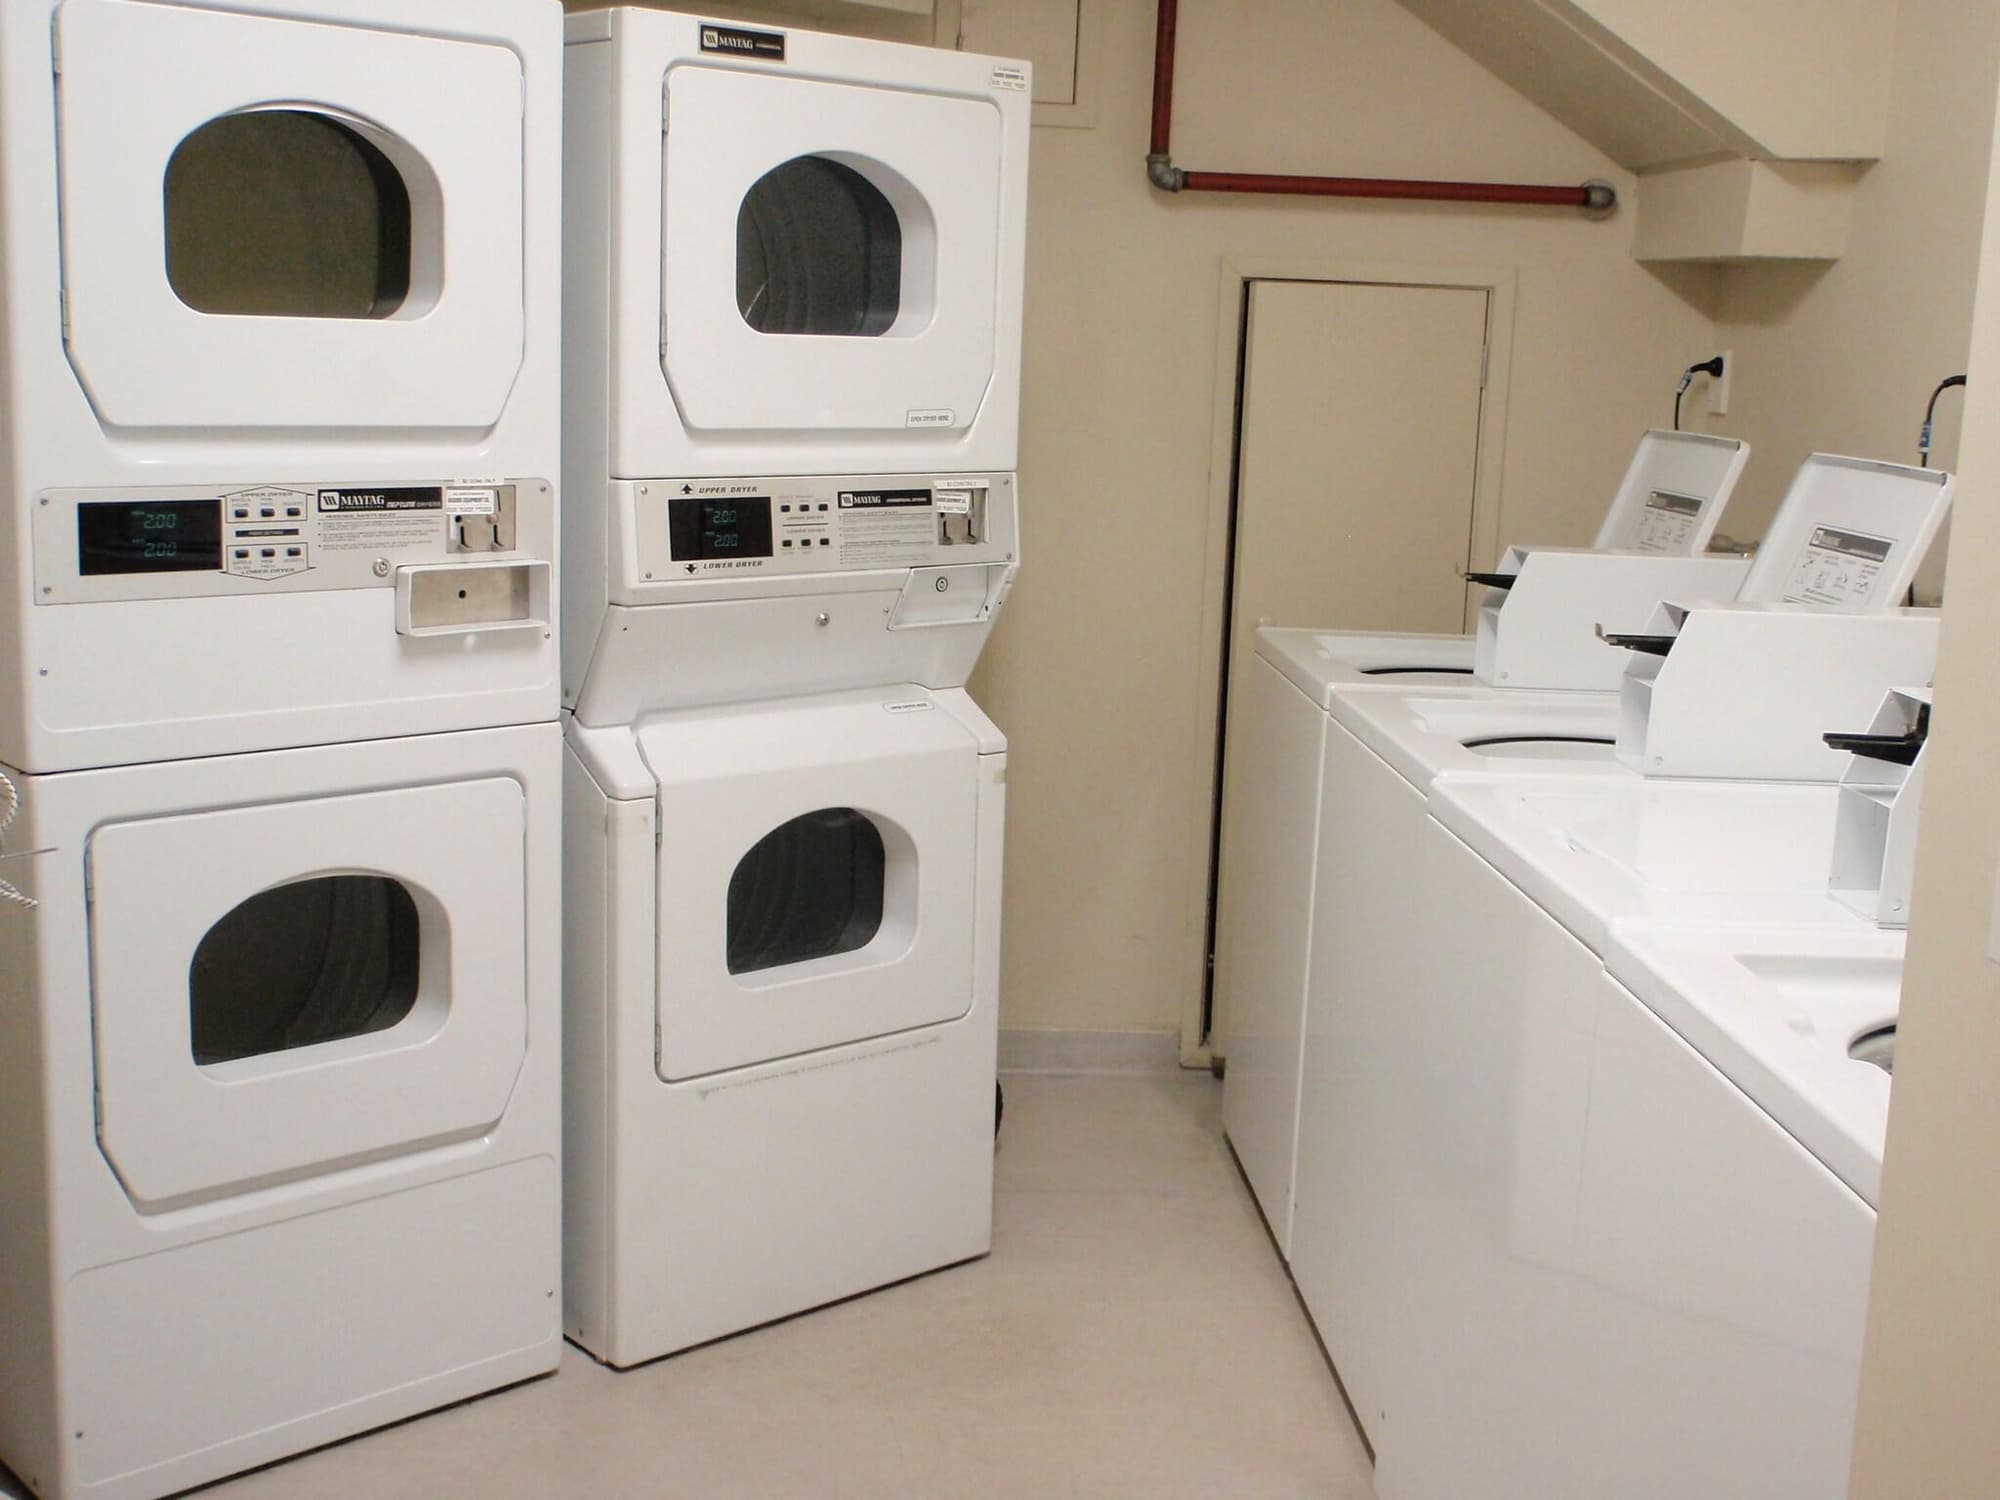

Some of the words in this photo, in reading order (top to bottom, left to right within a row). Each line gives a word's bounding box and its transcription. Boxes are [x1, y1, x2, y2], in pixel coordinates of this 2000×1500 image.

[719, 36, 753, 49] MAYTAG
[340, 495, 385, 505] MAYTAG
[853, 495, 881, 504] MAYTAG
[736, 560, 763, 568] DRYER
